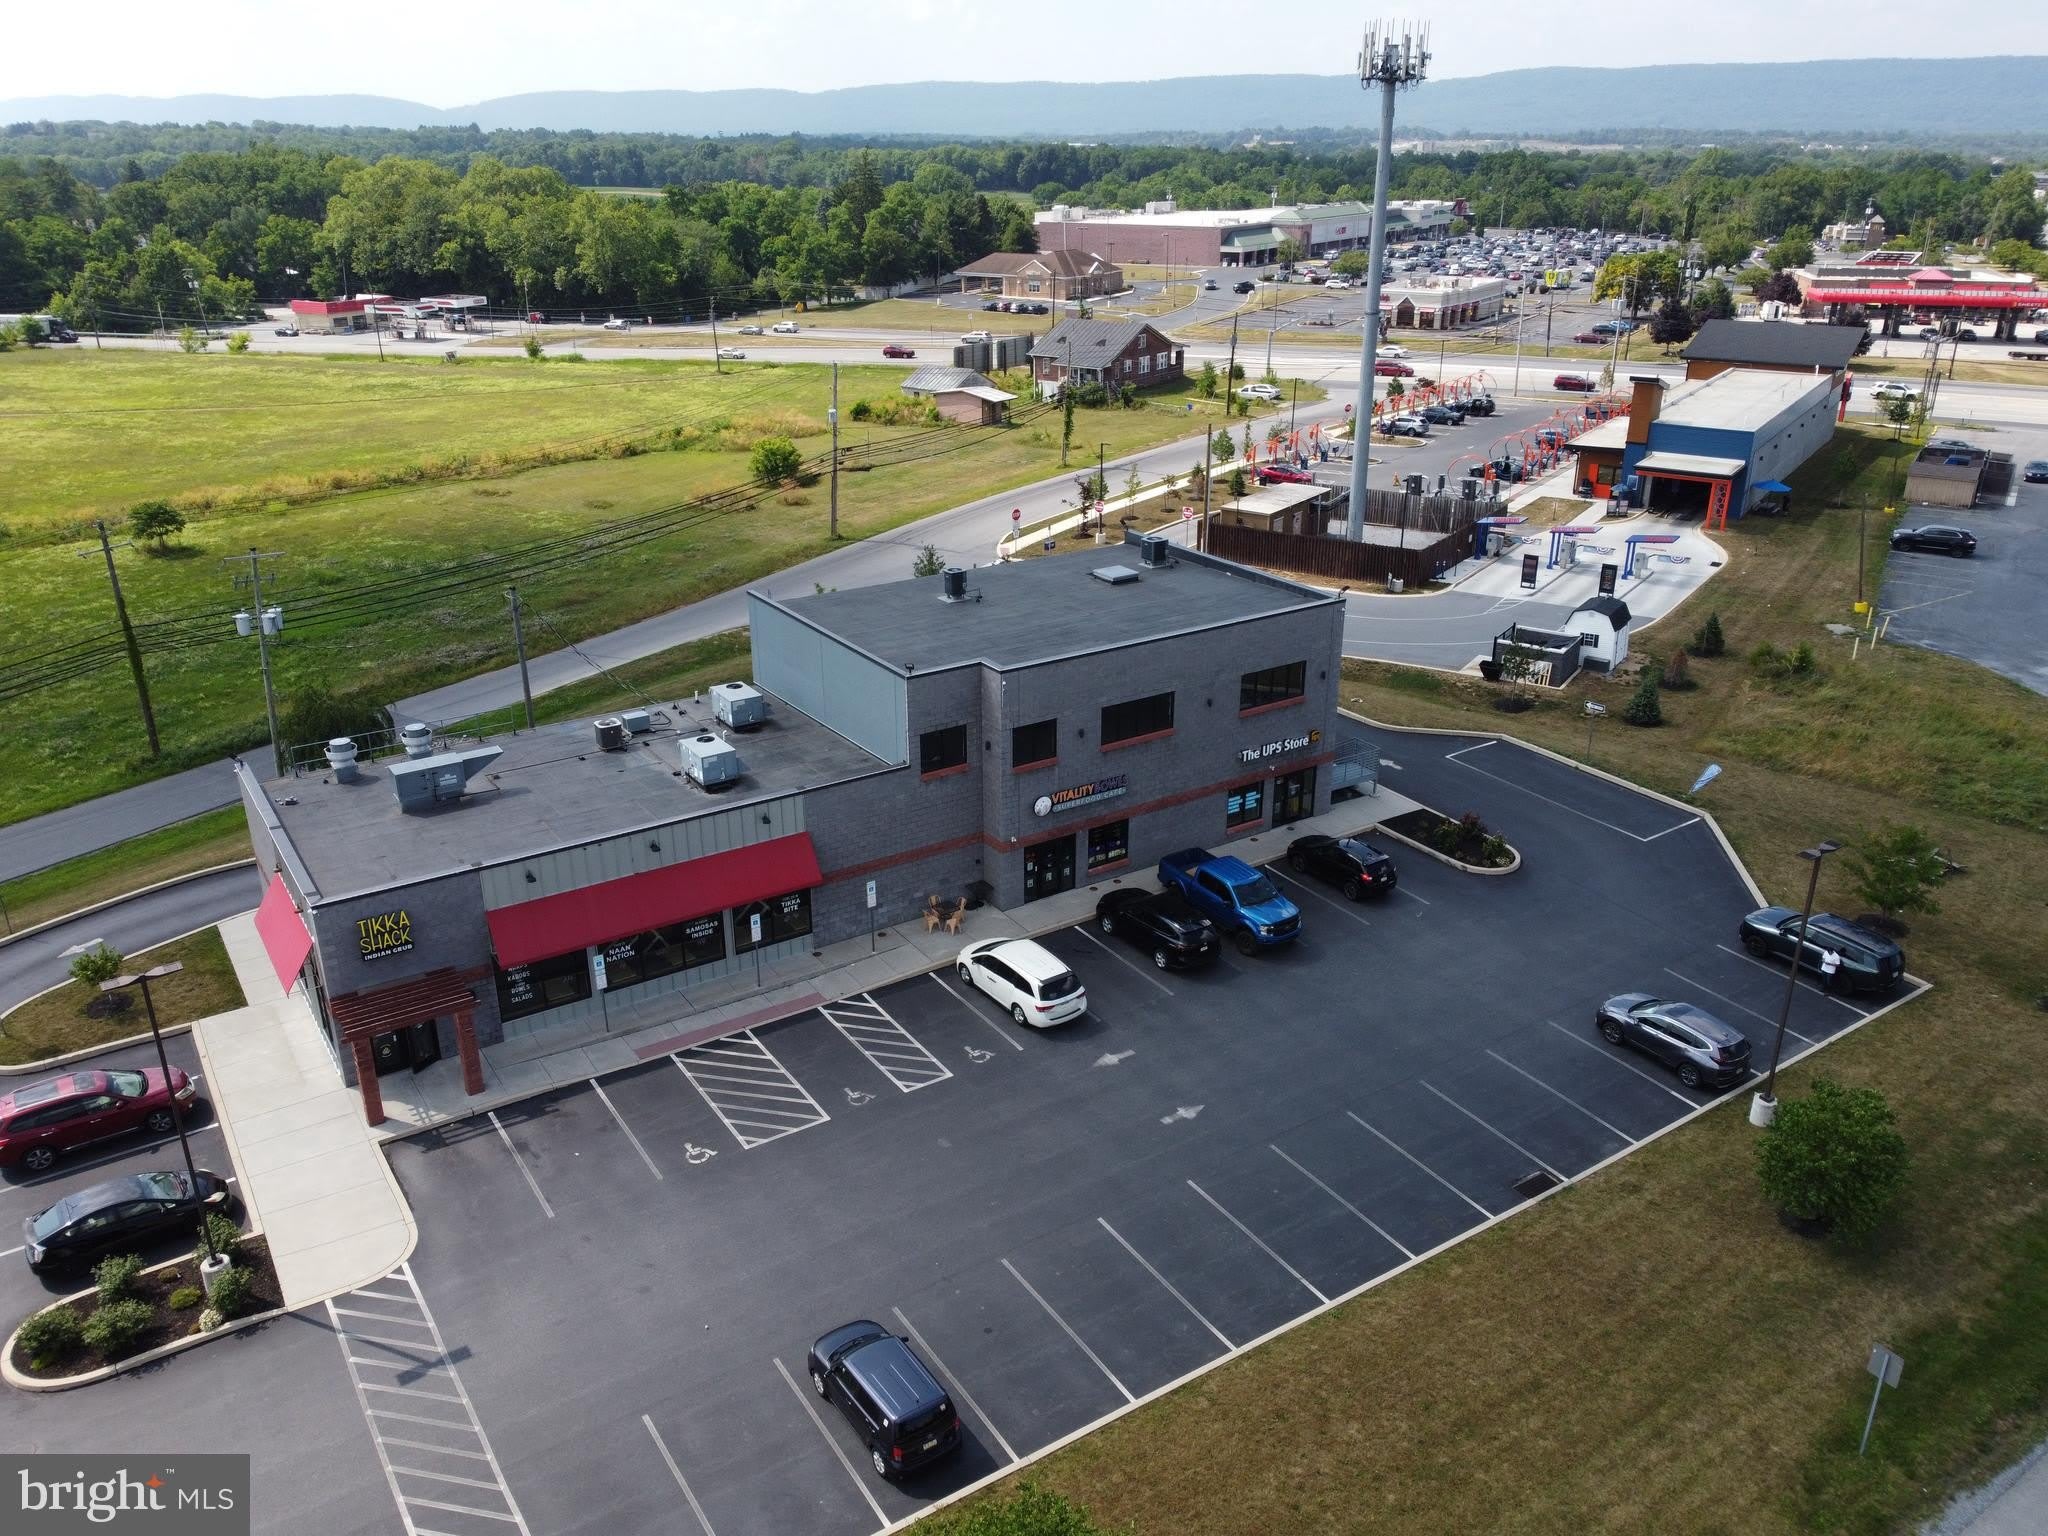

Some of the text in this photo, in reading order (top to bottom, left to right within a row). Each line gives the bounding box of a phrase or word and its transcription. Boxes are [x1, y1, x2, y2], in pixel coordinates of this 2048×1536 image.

[1242, 737, 1309, 762] The UPS Store
[781, 898, 801, 908] TIKKA
[783, 905, 799, 913] BITE
[356, 910, 410, 937] TIKKA
[686, 921, 718, 934] SAMOSAS
[360, 926, 413, 953] SHACK
[691, 929, 713, 938] INSIDE
[364, 943, 413, 961] INDIAN GRUB
[606, 950, 635, 963] NATION
[609, 944, 631, 956] NAAN
[511, 992, 534, 1004] SALADS
